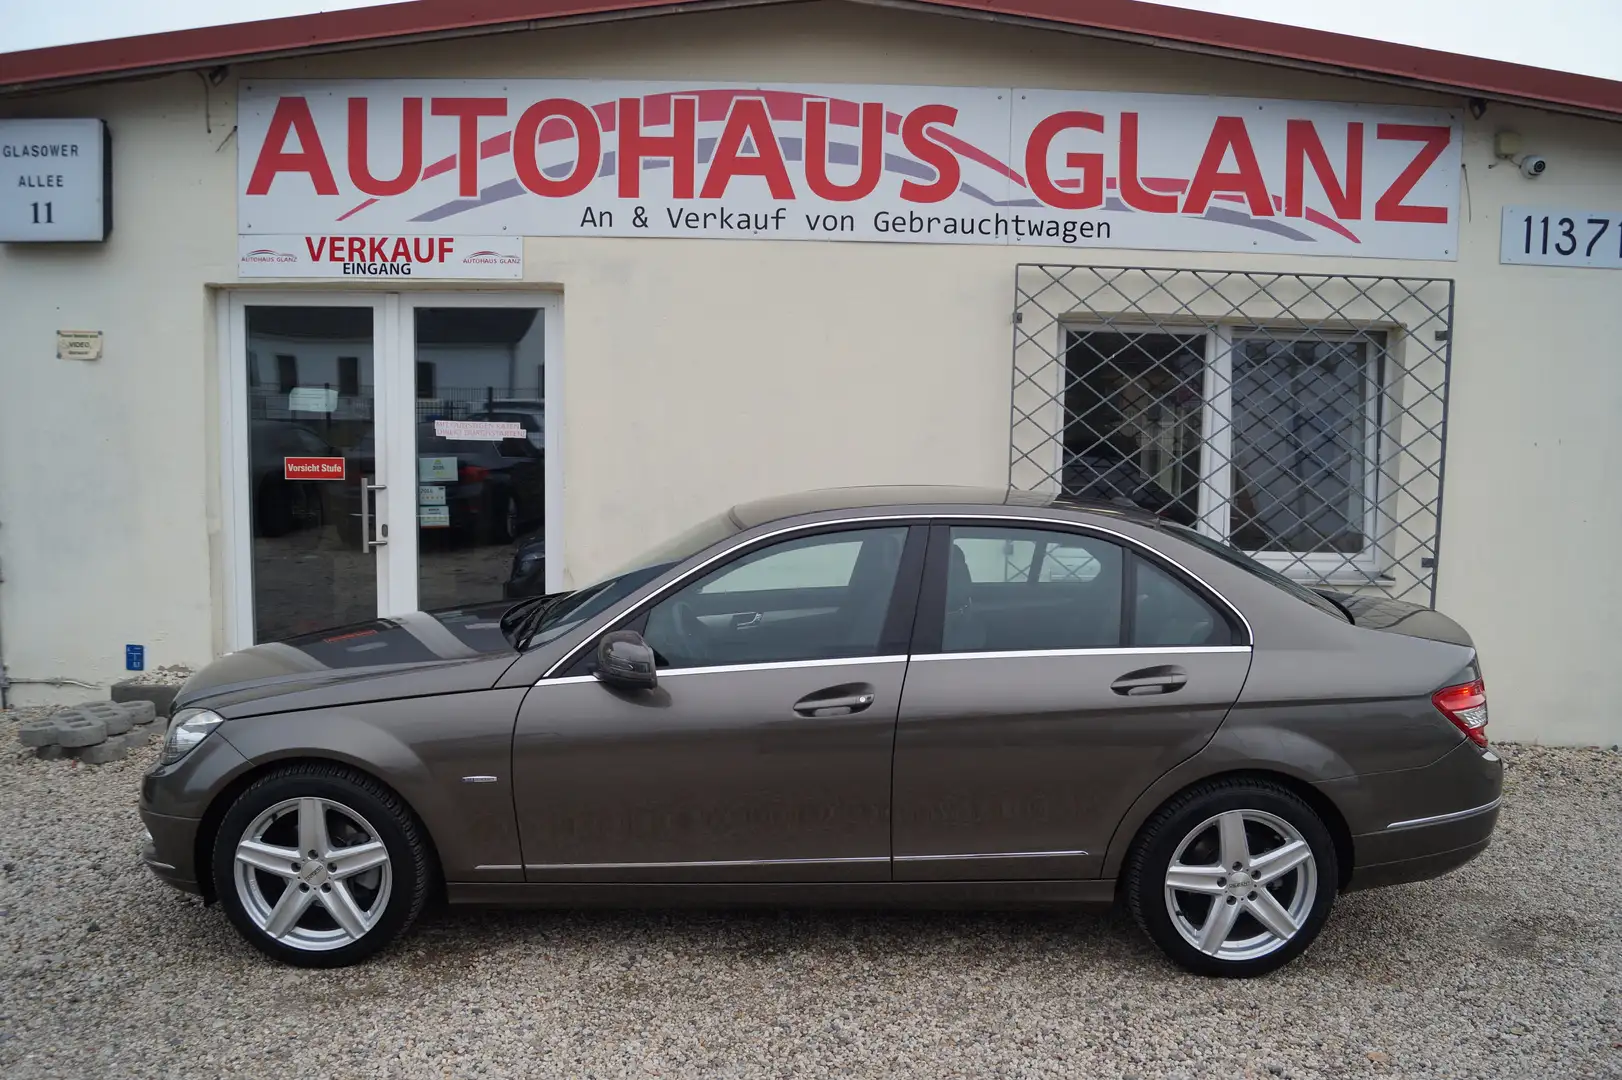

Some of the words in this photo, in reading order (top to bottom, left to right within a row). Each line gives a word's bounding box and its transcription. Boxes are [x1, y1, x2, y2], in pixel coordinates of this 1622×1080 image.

[3, 144, 79, 158] GLASOWER
[246, 95, 961, 204] AUTOHAUS
[1025, 109, 1452, 225] GLANZ
[18, 174, 64, 188] ALLEE
[30, 201, 55, 225] 11
[580, 206, 613, 228] An
[632, 206, 649, 229] &
[666, 206, 787, 231] Verkauf
[805, 213, 855, 232] von
[873, 211, 1112, 244] Gebrauchtwagen
[305, 236, 454, 264] VERKAUF
[342, 262, 412, 275] EINGANG
[287, 463, 320, 473] Vorsicht
[321, 464, 342, 473] Stufe
